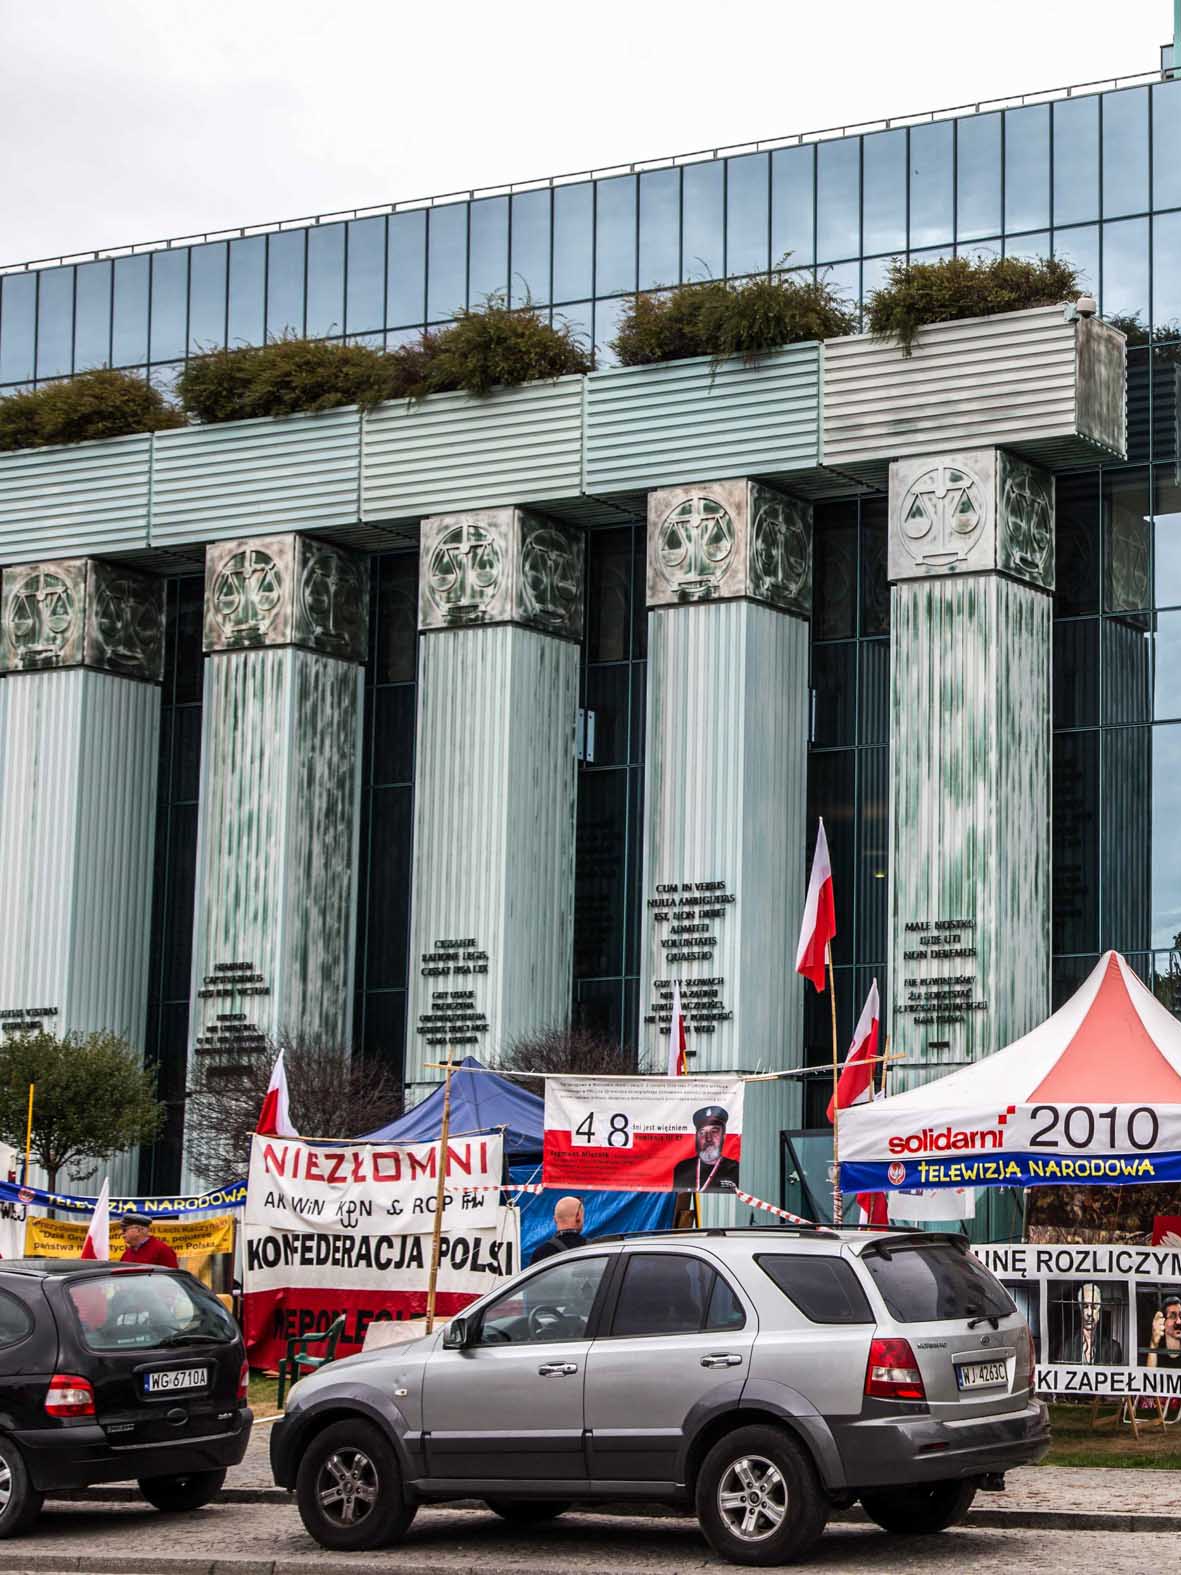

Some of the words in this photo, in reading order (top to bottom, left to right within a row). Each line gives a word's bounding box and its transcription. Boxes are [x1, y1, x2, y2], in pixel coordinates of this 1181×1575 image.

[888, 1123, 1004, 1155] solidarni
[1030, 1105, 1160, 1150] 2010
[263, 1142, 488, 1184] NIEZŁOMNI
[918, 1161, 1021, 1183] TELEWIZJA
[1029, 1158, 1155, 1177] NARODOWA
[49, 1194, 137, 1213] TELEWZJA
[145, 1187, 248, 1211] NARODOWA
[264, 1191, 287, 1209] AK
[247, 1233, 423, 1271] KONFEDERACJA
[438, 1236, 513, 1276] POLSKI
[152, 1373, 170, 1389] WG
[173, 1368, 208, 1387] 6710A
